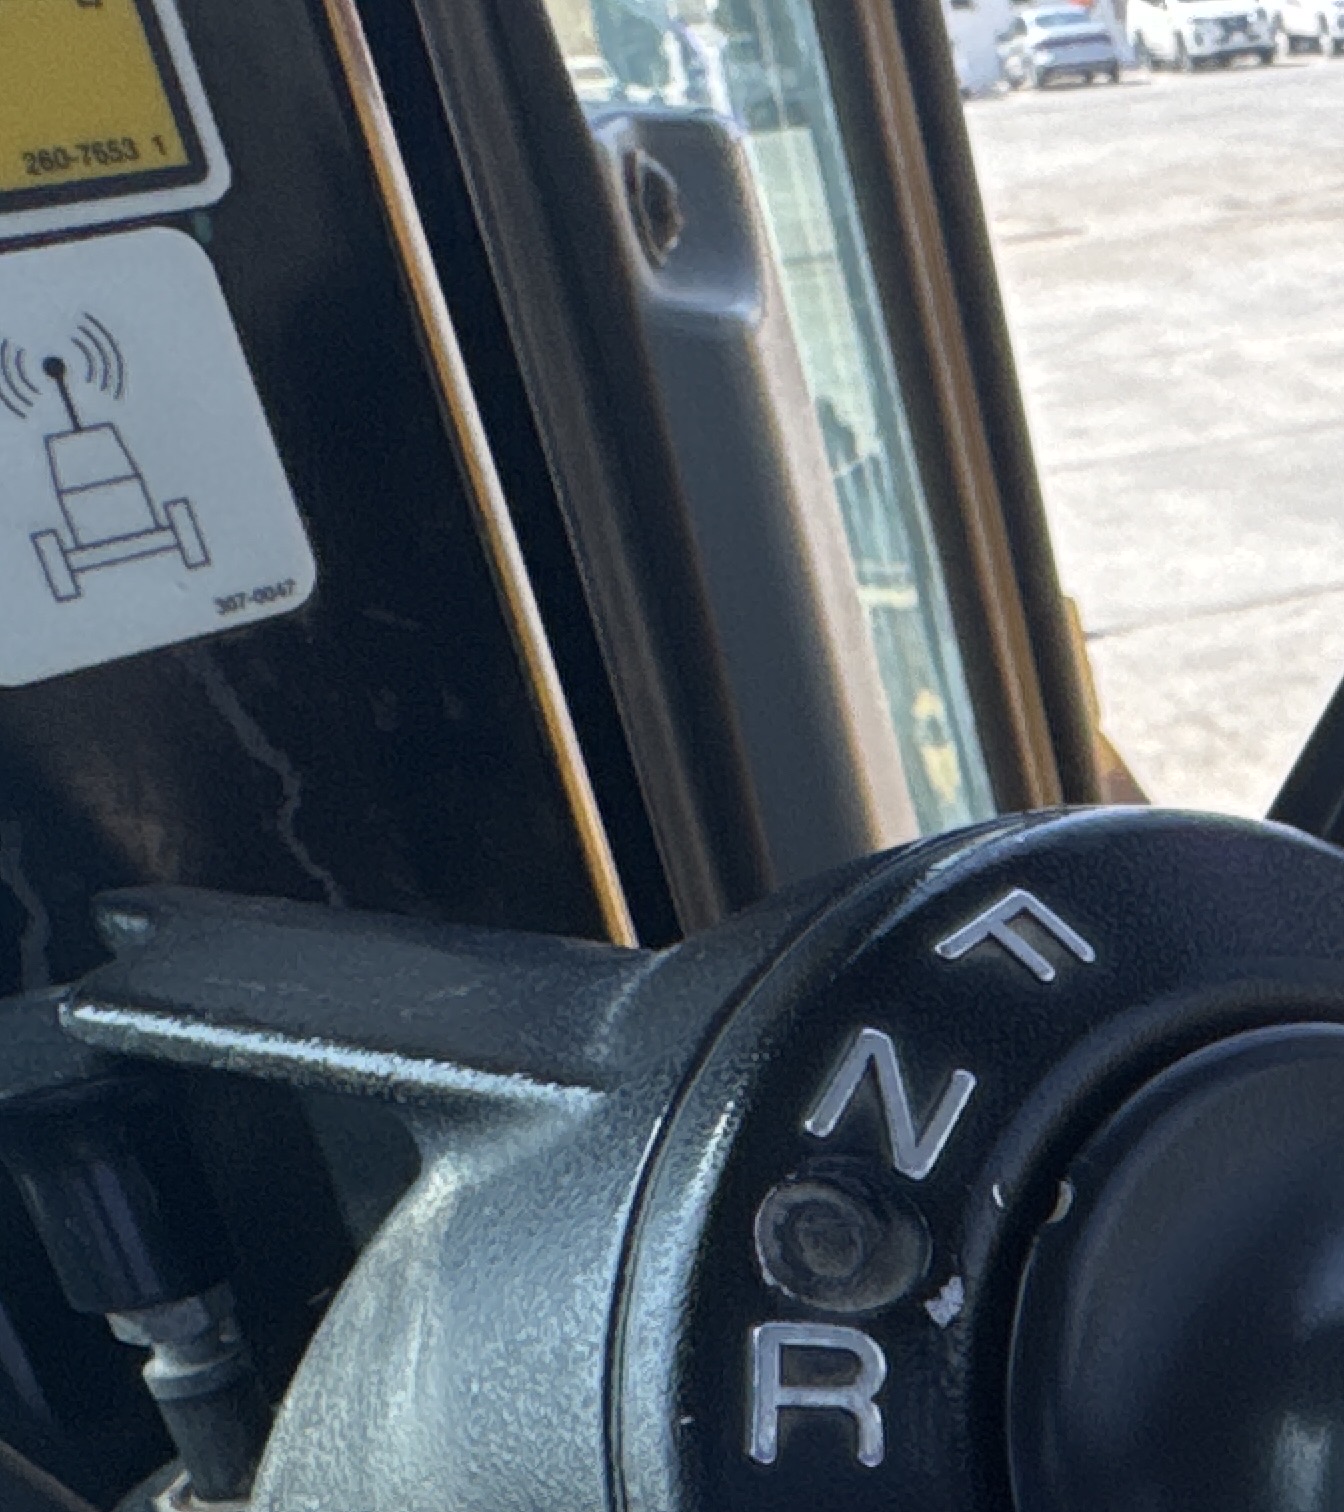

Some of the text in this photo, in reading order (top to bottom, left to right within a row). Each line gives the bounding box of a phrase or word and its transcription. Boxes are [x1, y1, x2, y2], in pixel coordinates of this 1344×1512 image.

[933, 887, 1096, 982] F
[804, 1027, 977, 1179] N
[748, 1321, 887, 1468] R
